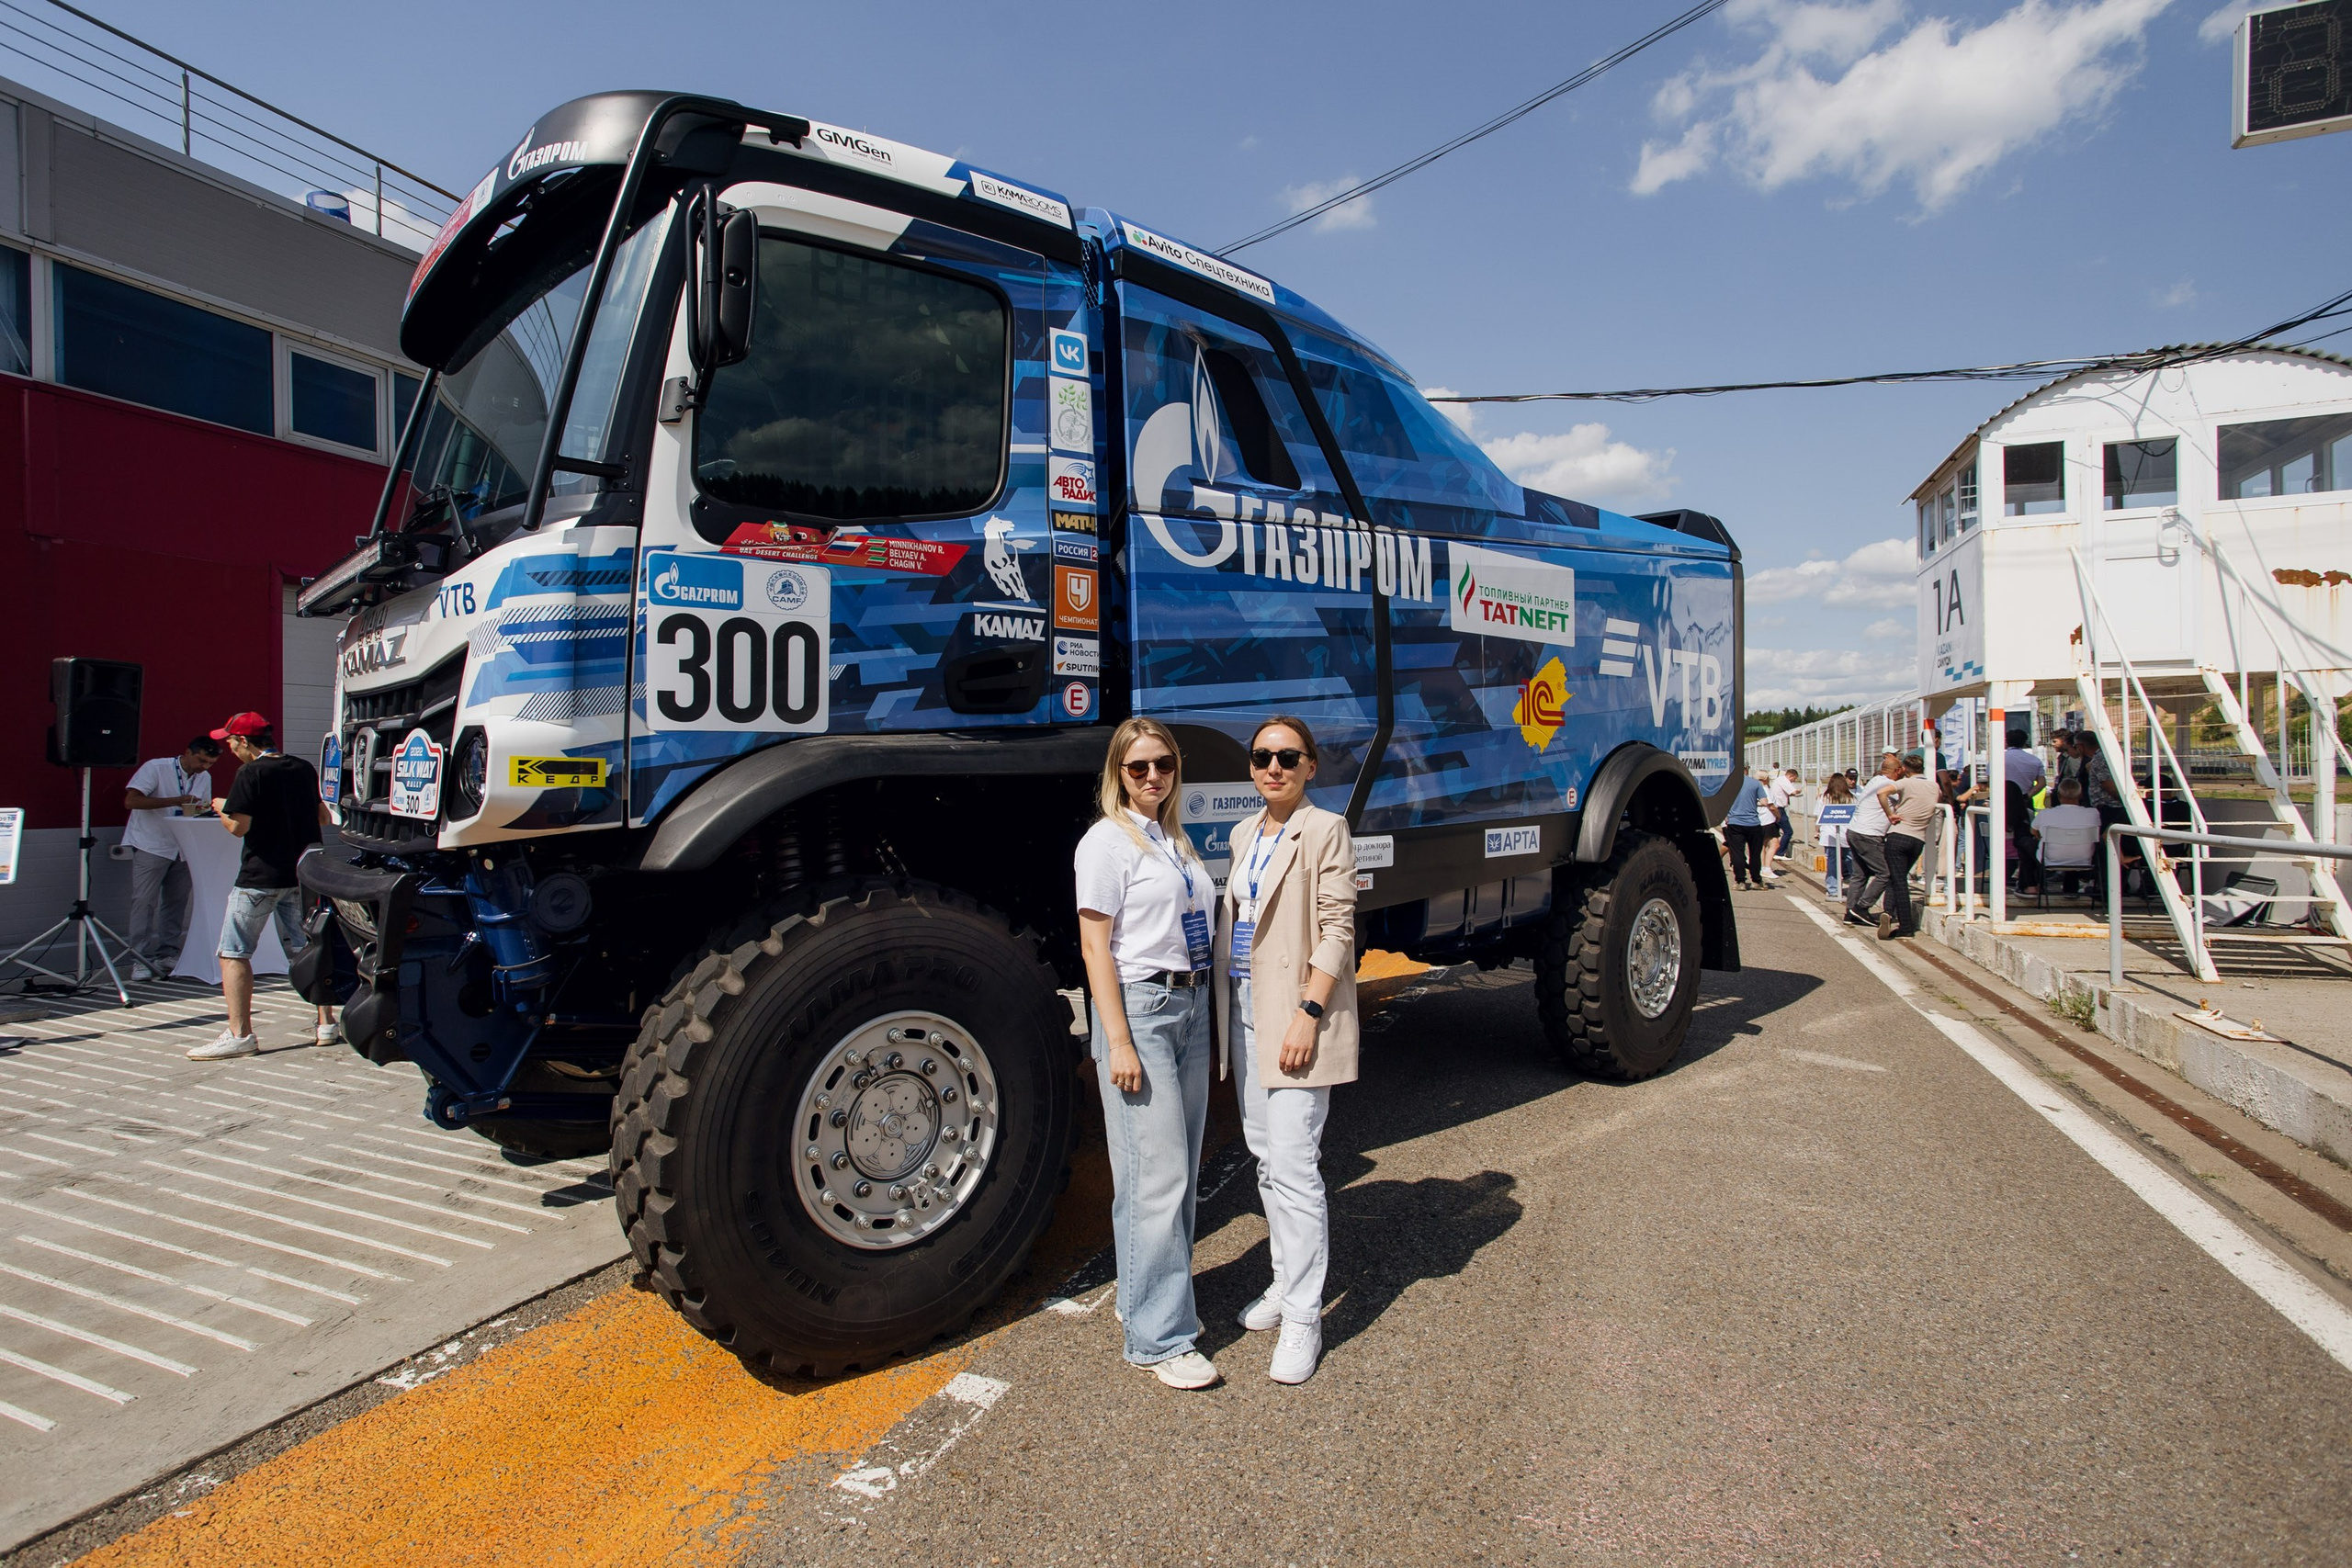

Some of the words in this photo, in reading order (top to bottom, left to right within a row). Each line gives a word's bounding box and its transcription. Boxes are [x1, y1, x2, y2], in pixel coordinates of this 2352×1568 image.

[817, 128, 891, 162] GMGen
[521, 141, 589, 174] ГАЗПРОМ
[1148, 235, 1182, 259] Avito
[1184, 251, 1270, 298] Спецтехника
[1059, 344, 1080, 362] VK
[1053, 475, 1085, 490] АВТО
[755, 548, 780, 557] DESERT
[782, 552, 818, 560] CHALLENGE
[888, 540, 937, 553] MINNIKHANOV
[937, 546, 945, 555] R.
[888, 549, 919, 560] BELYAEV
[919, 553, 927, 561] A.
[1058, 545, 1089, 557] РОССИЯ
[1239, 493, 1433, 604] ГАЗПРОМ
[888, 558, 915, 570] CHAGIN
[916, 562, 923, 570] V.
[438, 581, 476, 619] VTB
[681, 586, 738, 604] GAZPROM
[772, 595, 802, 604] CAMF
[1479, 585, 1532, 604] ТОПЛИВНЫЙ
[1534, 596, 1569, 611] ПАРТНЕР
[1059, 615, 1098, 626] ЧЕМПИОНАТ
[1479, 599, 1569, 633] TATNEFT
[974, 614, 1046, 641] KAMAZ
[657, 613, 820, 724] 300
[1643, 644, 1723, 730] VTB
[1070, 689, 1083, 710] E
[397, 761, 414, 777] SILK
[416, 761, 436, 779] WAY
[517, 774, 599, 784] КЕДР
[405, 795, 420, 815] 300
[1363, 841, 1391, 851] доктора
